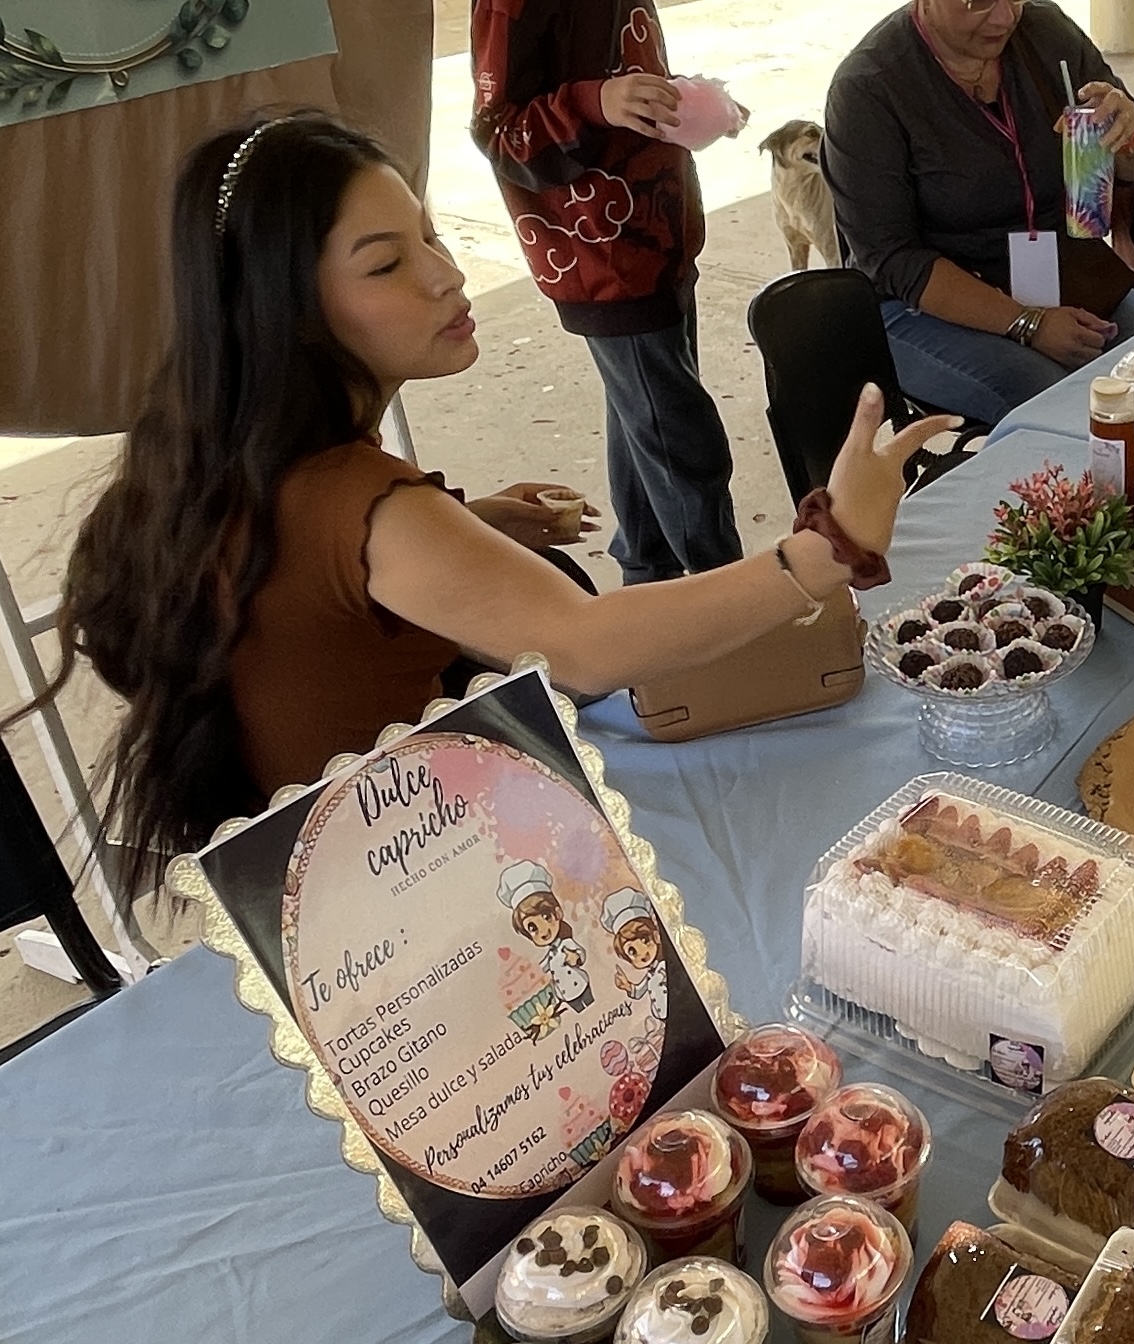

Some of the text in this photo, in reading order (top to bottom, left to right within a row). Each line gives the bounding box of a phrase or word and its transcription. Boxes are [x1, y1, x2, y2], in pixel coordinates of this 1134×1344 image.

[356, 756, 432, 827] Dulce
[367, 776, 469, 876] capricho
[428, 854, 450, 872] CON
[452, 834, 481, 858] AMOR
[301, 968, 332, 1012] Te
[336, 939, 395, 993] ofrece
[324, 940, 484, 1058] Tortas Personalizadas
[338, 1017, 412, 1075] Cupcakes
[351, 1022, 448, 1099] Brazo Gitano
[368, 1066, 430, 1117] Quesillo
[385, 1031, 524, 1143] Mesa dulce y salada
[423, 1000, 633, 1177] Personalizamos tus celebraciones
[471, 1126, 547, 1194] 04 14607 5162
